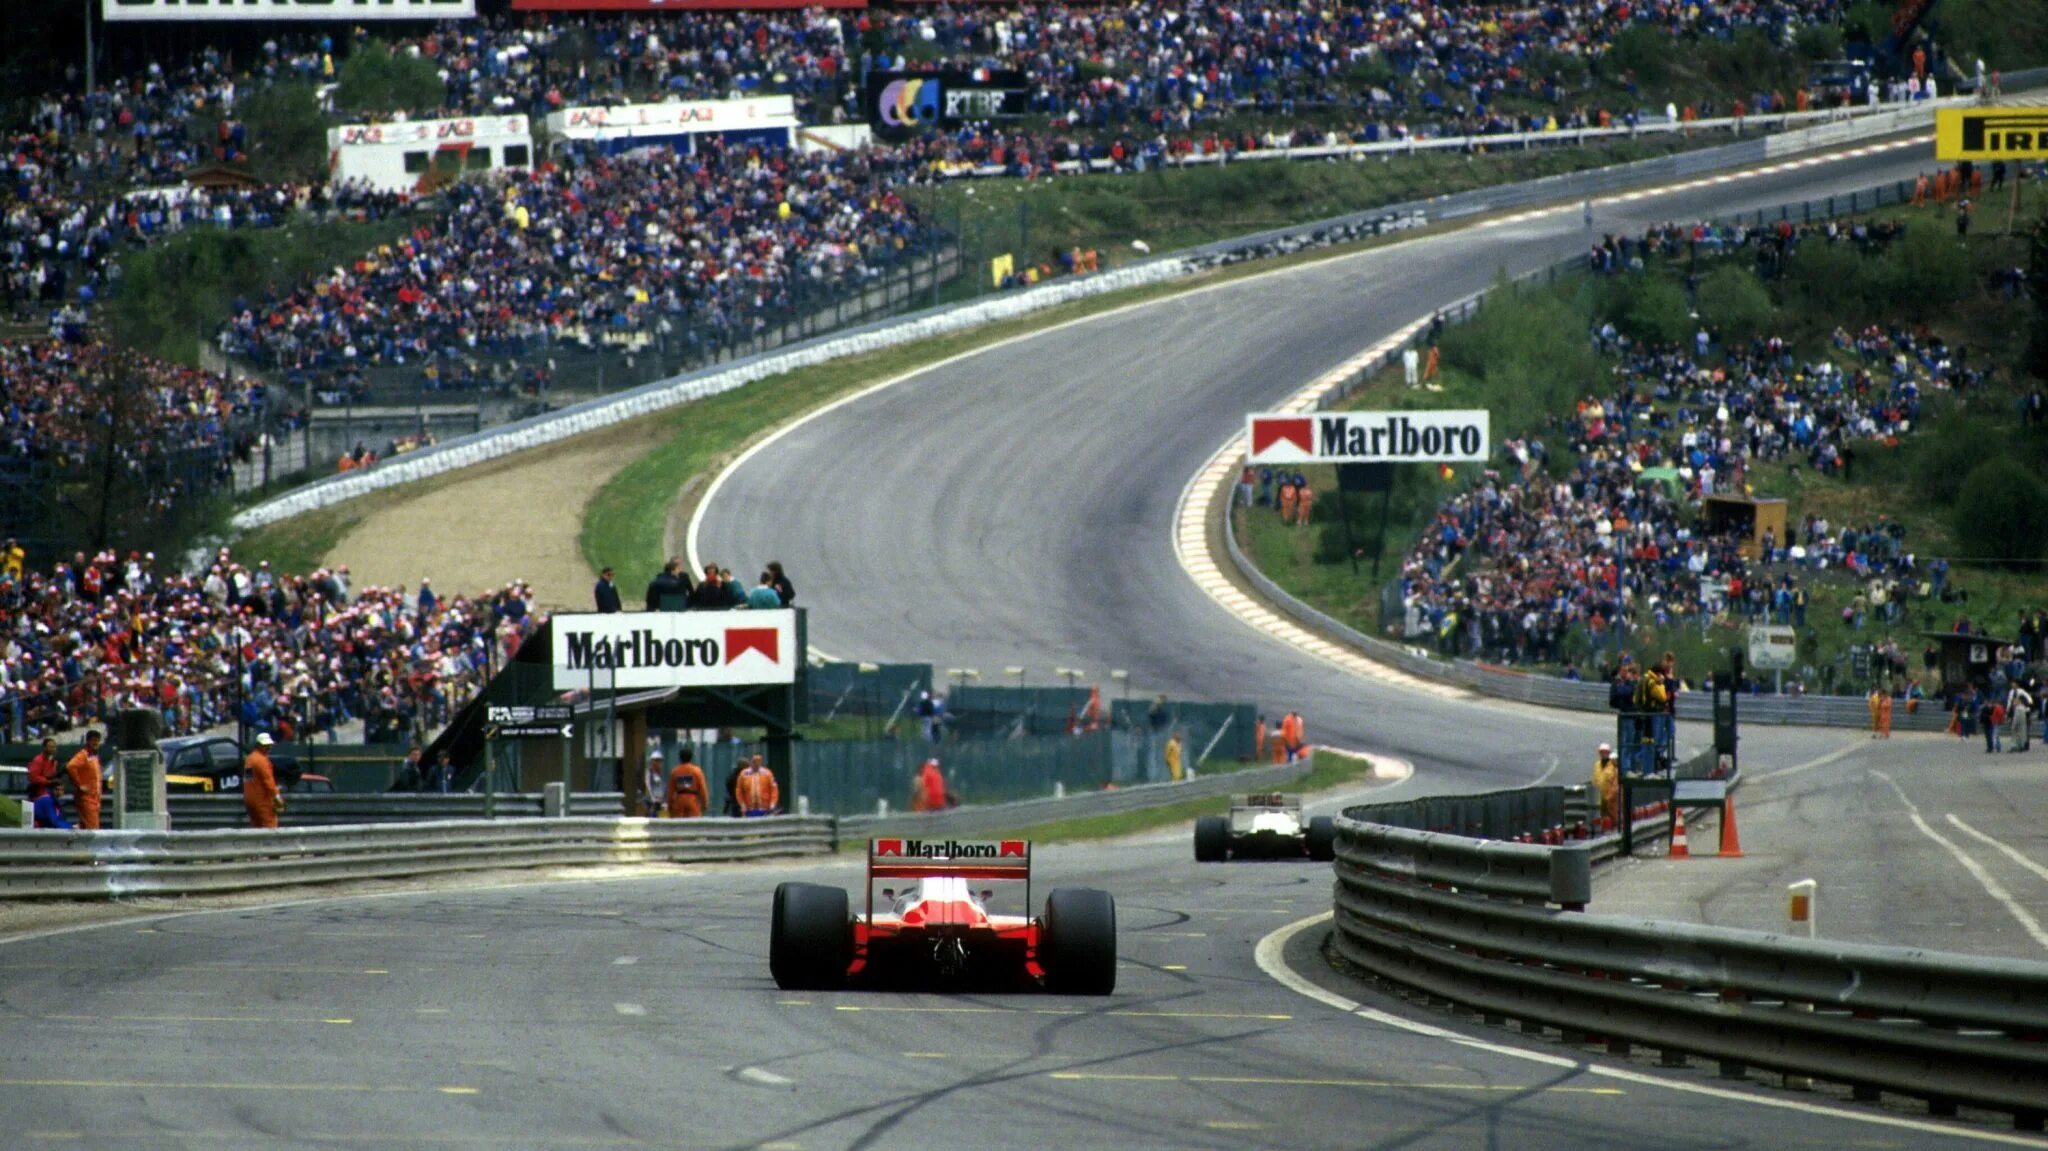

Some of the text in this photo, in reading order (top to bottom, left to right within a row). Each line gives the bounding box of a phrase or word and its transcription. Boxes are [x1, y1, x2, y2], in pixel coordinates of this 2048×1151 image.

[946, 91, 1005, 117] RTBF
[1320, 417, 1481, 456] Marlboro
[565, 629, 719, 669] Marlboro
[220, 774, 240, 790] LAD
[906, 840, 997, 858] Marlboro
